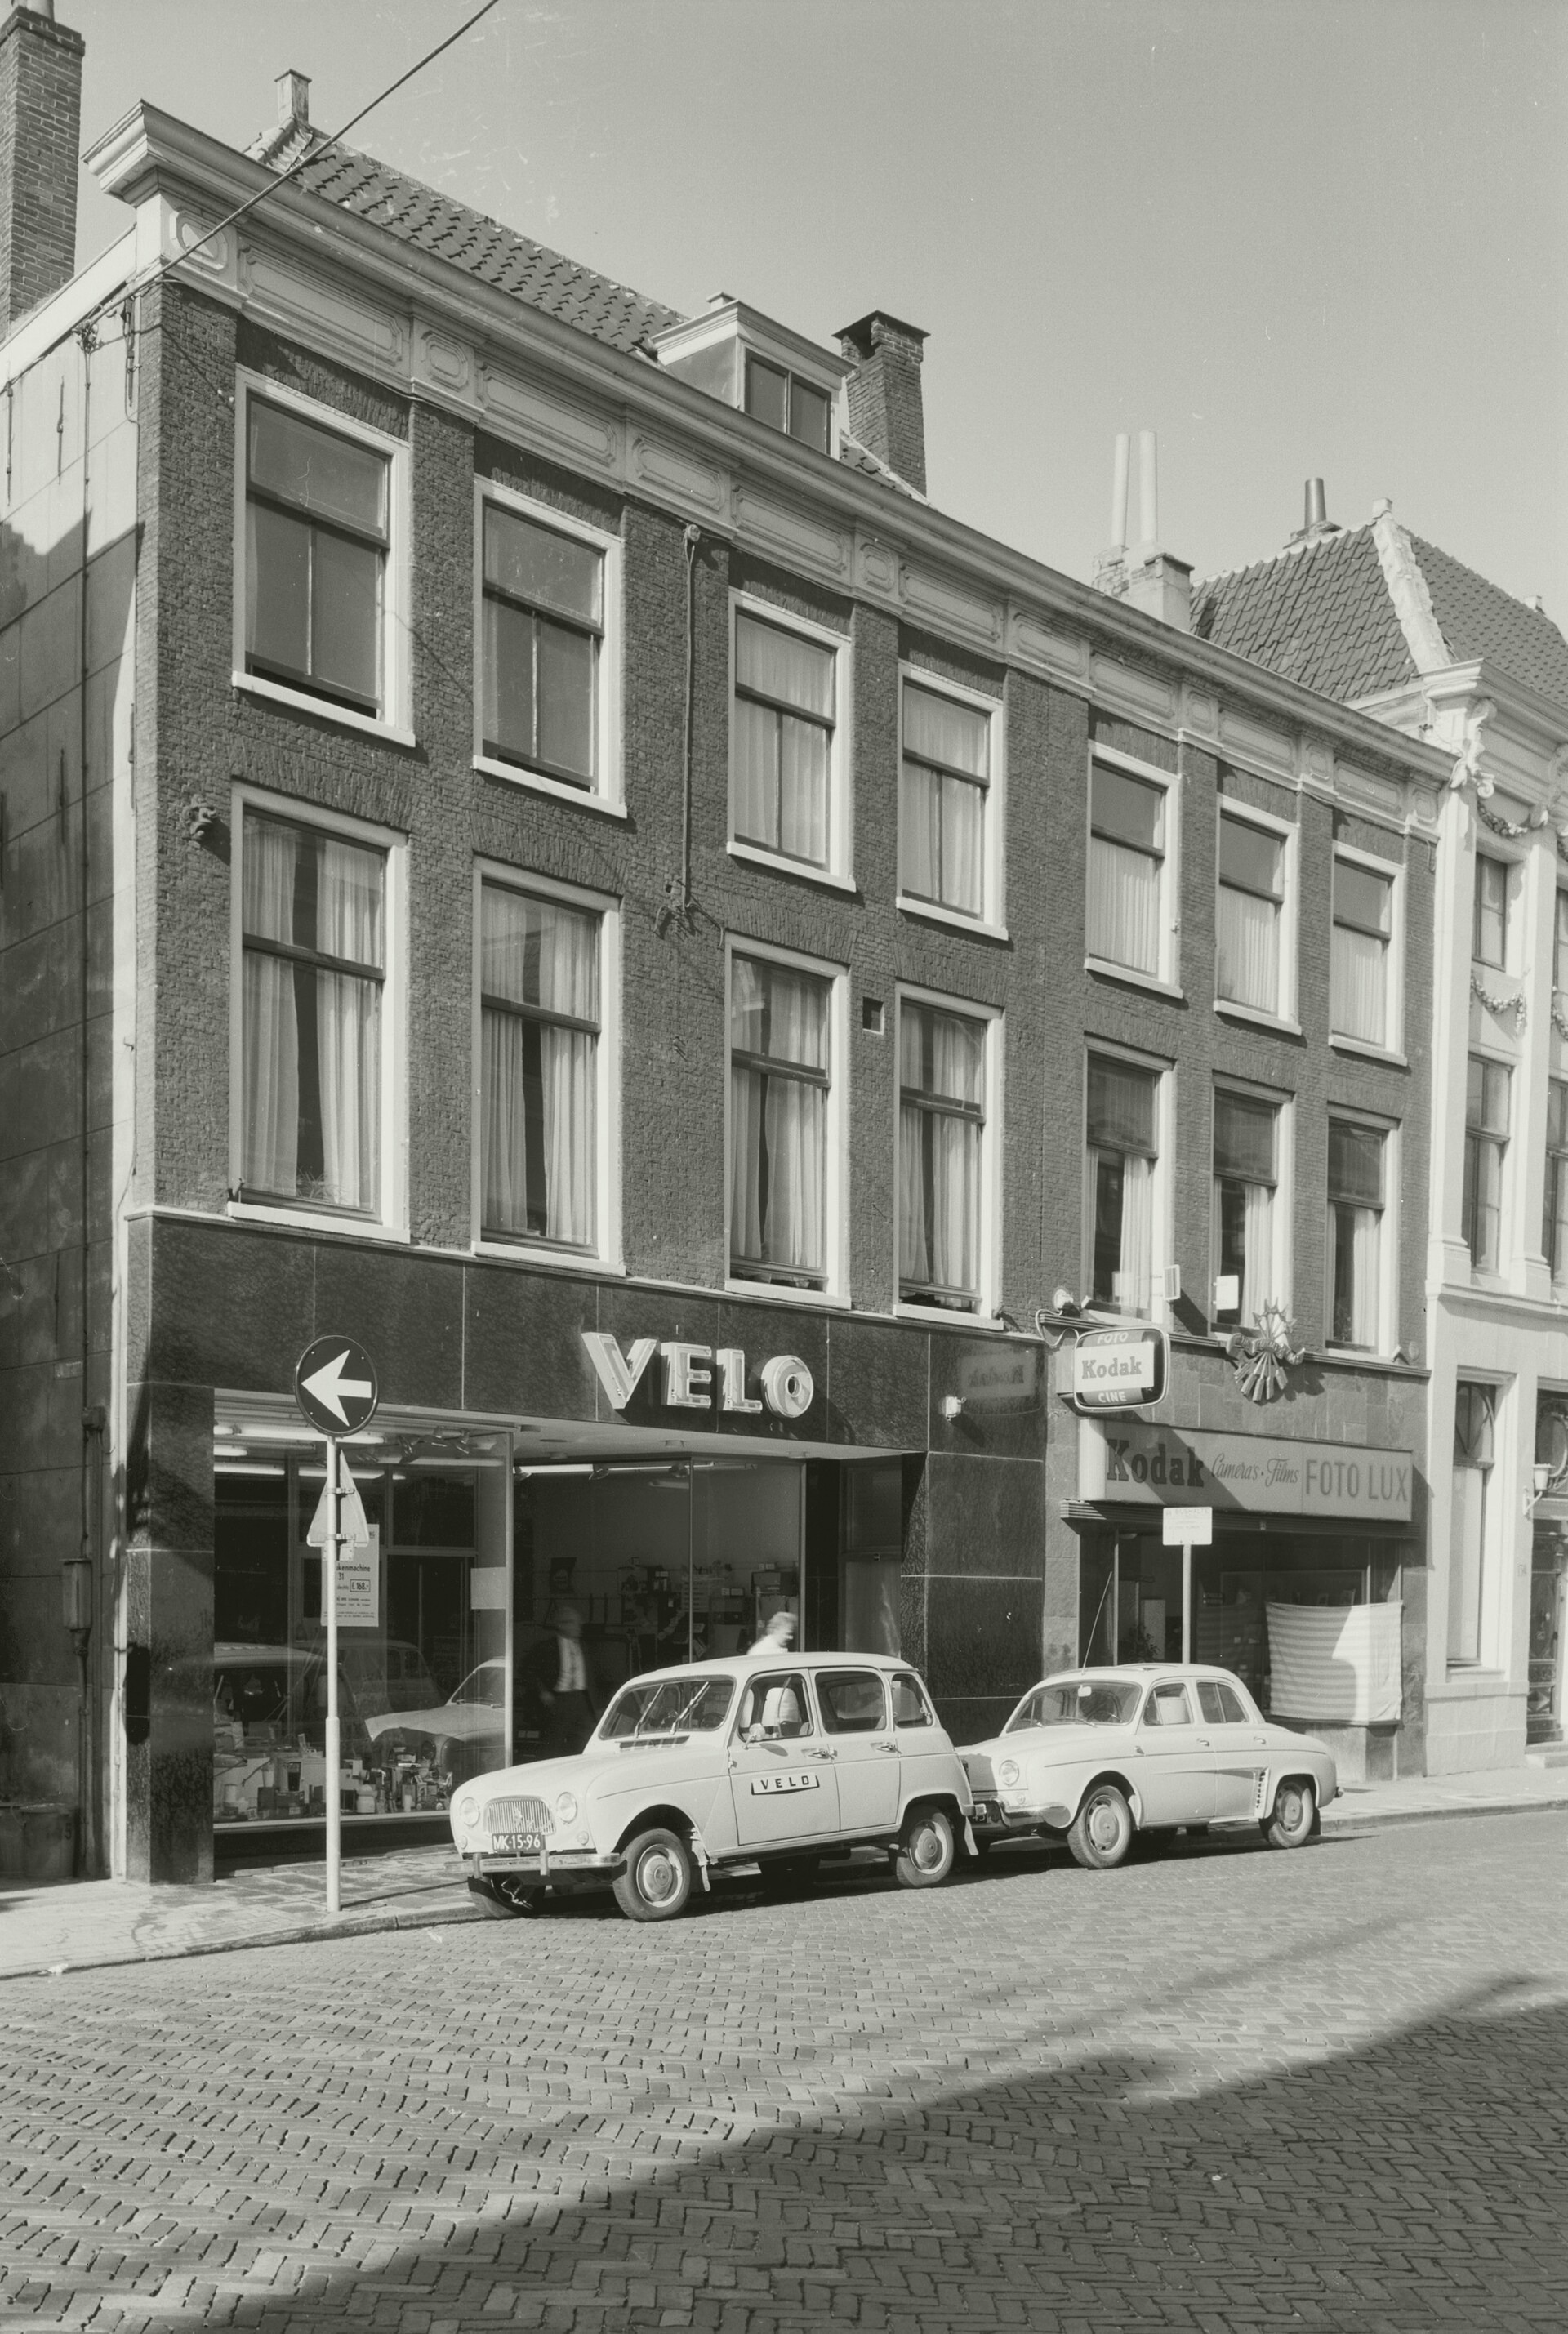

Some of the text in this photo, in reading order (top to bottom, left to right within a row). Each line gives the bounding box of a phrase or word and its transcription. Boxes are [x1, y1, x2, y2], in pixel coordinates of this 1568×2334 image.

[1097, 1332, 1128, 1345] FOTO
[581, 1331, 814, 1419] VELO
[1081, 1356, 1142, 1379] Kodak
[1098, 1391, 1127, 1403] CINE
[1107, 1438, 1205, 1488] Kodak
[1265, 1458, 1299, 1487] Films
[1306, 1459, 1359, 1498] FOTO
[1368, 1464, 1409, 1502] LUX
[760, 1775, 809, 1790] VELO
